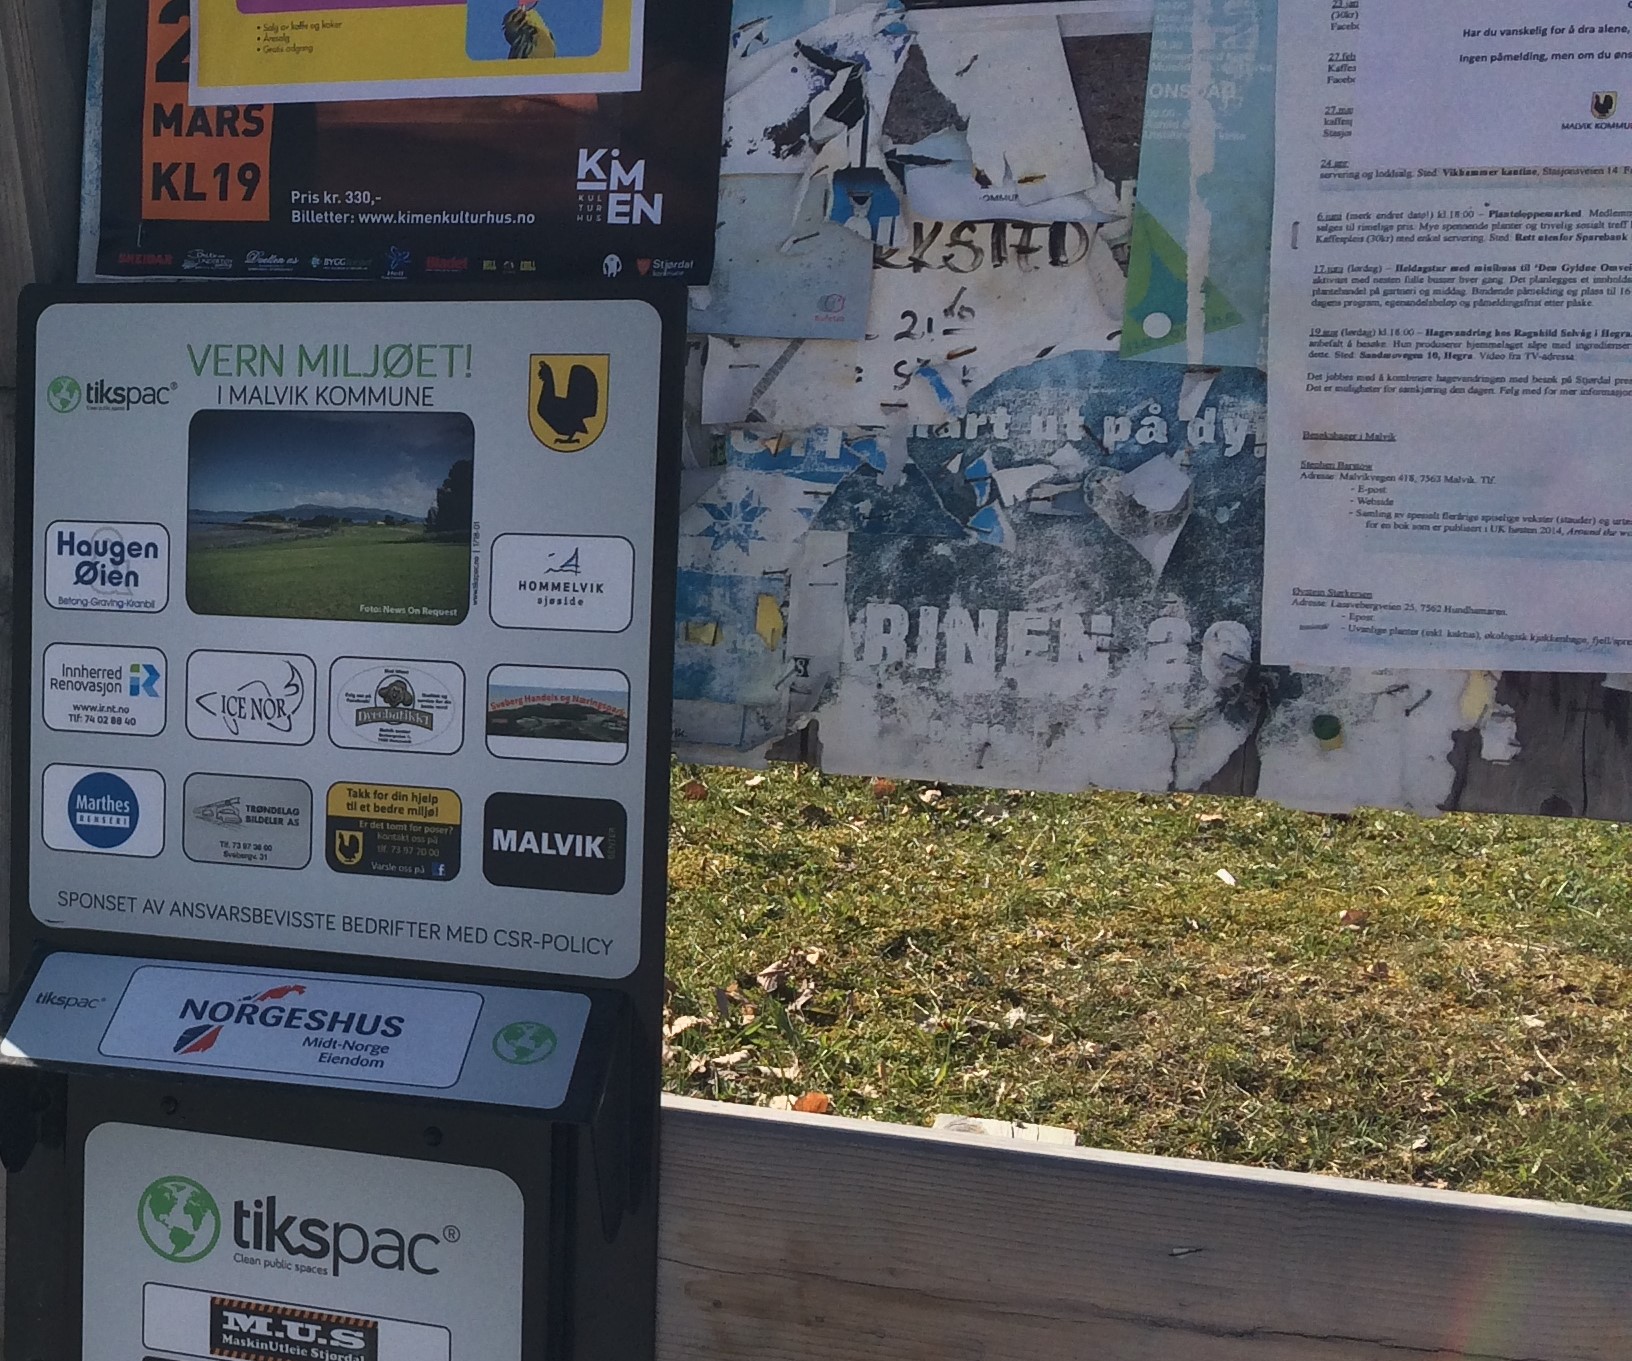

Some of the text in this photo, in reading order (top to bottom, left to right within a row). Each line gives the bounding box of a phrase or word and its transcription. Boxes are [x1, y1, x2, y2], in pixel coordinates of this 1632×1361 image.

[1463, 23, 1630, 38] Har du vanskelig for å dra alene,
[1459, 53, 1488, 64] Ingen
[1490, 52, 1549, 64] påmelding,
[1551, 52, 1575, 61] men
[1577, 51, 1595, 61] om
[1597, 50, 1611, 60] du
[152, 103, 265, 138] MARS
[290, 190, 382, 207] Pris kr. 330,-
[290, 210, 536, 225] Billetter: www.kimenkulturhus.no
[652, 258, 694, 271] Stjørdal
[186, 343, 473, 379] VERN MILJØET!
[217, 385, 434, 407] I MALVIK KOMMUNE
[1103, 403, 1168, 455] på
[57, 530, 159, 566] Haugen
[73, 560, 139, 588] Øien
[518, 580, 604, 594] HOMMELVIK
[359, 604, 458, 617] Foto: News On Request
[537, 596, 584, 607] sjøside
[61, 663, 123, 680] Innherred
[50, 677, 123, 697] Renovasjon
[220, 694, 289, 722] ICE NOR
[490, 697, 523, 710] Sveberg
[560, 694, 570, 704] og
[84, 714, 95, 724] 74
[97, 715, 109, 724] 02
[124, 716, 137, 726] 40
[76, 794, 130, 814] Marthes
[347, 787, 439, 806] Takk for din hjelp
[245, 804, 300, 816] TRØNDELAG
[346, 801, 439, 818] til et bedre miljø!
[245, 815, 300, 827] BILDELER AS
[359, 820, 454, 835] Er det tomt for poser?
[492, 828, 605, 859] MALVIK
[371, 862, 396, 872] Varsle
[398, 865, 412, 873] oss
[414, 866, 425, 874] på
[58, 891, 613, 957] SPONSET AV ANSVARSBEVISSTE BEDRIFTER MED CSR-POLICY
[179, 998, 405, 1038] NORGESHUS
[302, 1035, 389, 1056] Midt-Norge
[318, 1051, 385, 1069] Eiendom
[233, 1253, 328, 1277] Clean public spaces
[222, 1310, 366, 1350] M.U.S
[222, 1333, 308, 1357] MaskinUtleie
